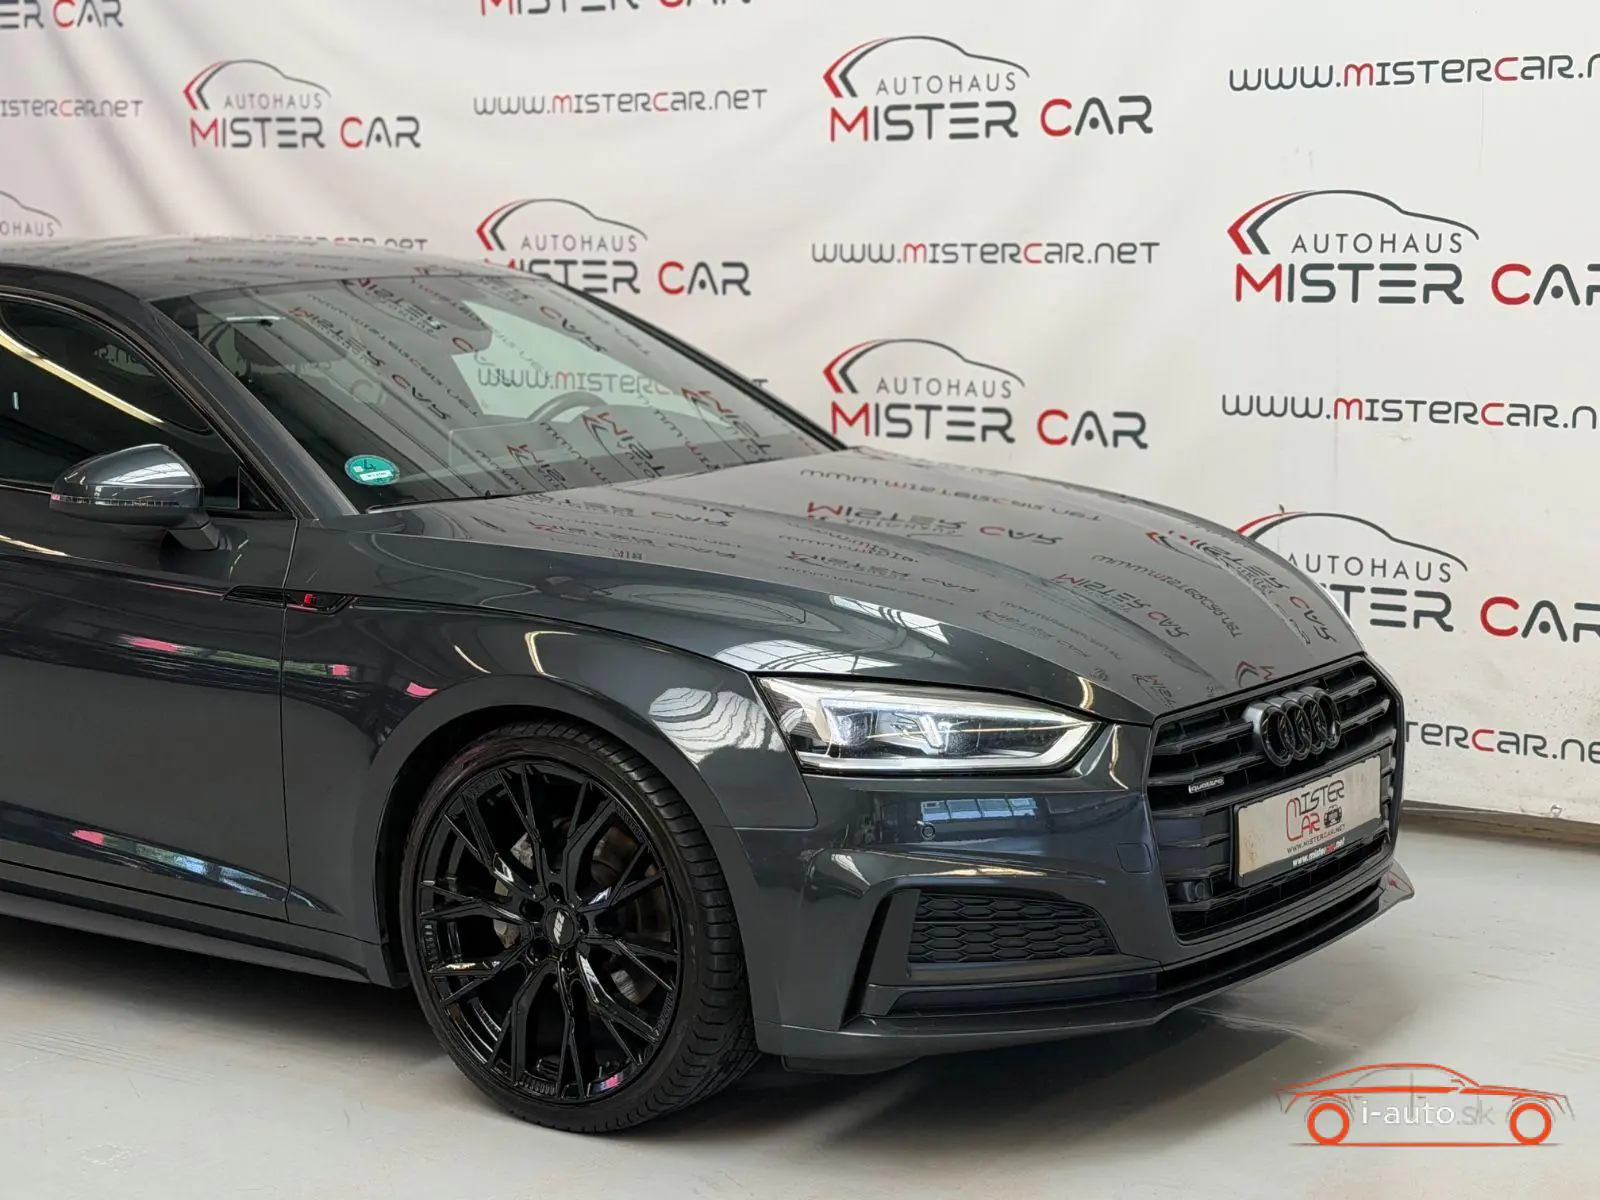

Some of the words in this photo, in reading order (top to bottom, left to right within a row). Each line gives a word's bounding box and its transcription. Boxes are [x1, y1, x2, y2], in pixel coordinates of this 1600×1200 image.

[52, 0, 124, 28] CAR
[876, 72, 1016, 95] AUTOHAUS
[224, 93, 322, 110] AUTOHAUS
[190, 117, 326, 149] MISTER
[340, 116, 421, 149] CAR
[830, 100, 1019, 142] MISTER
[1040, 95, 1153, 137] CAR
[520, 234, 638, 253] AUTOHAUS
[1291, 232, 1462, 254] AUTOHAUS
[484, 258, 640, 294] STER
[658, 260, 751, 295] CAR
[1235, 263, 1464, 305] MISTER
[876, 376, 1012, 399] AUTOHAUS
[830, 401, 1016, 443] MISTER
[1036, 408, 1149, 449] CAR
[1319, 583, 1454, 632] TER
[1480, 596, 1600, 643] CAR
[1286, 780, 1345, 816] MISTER
